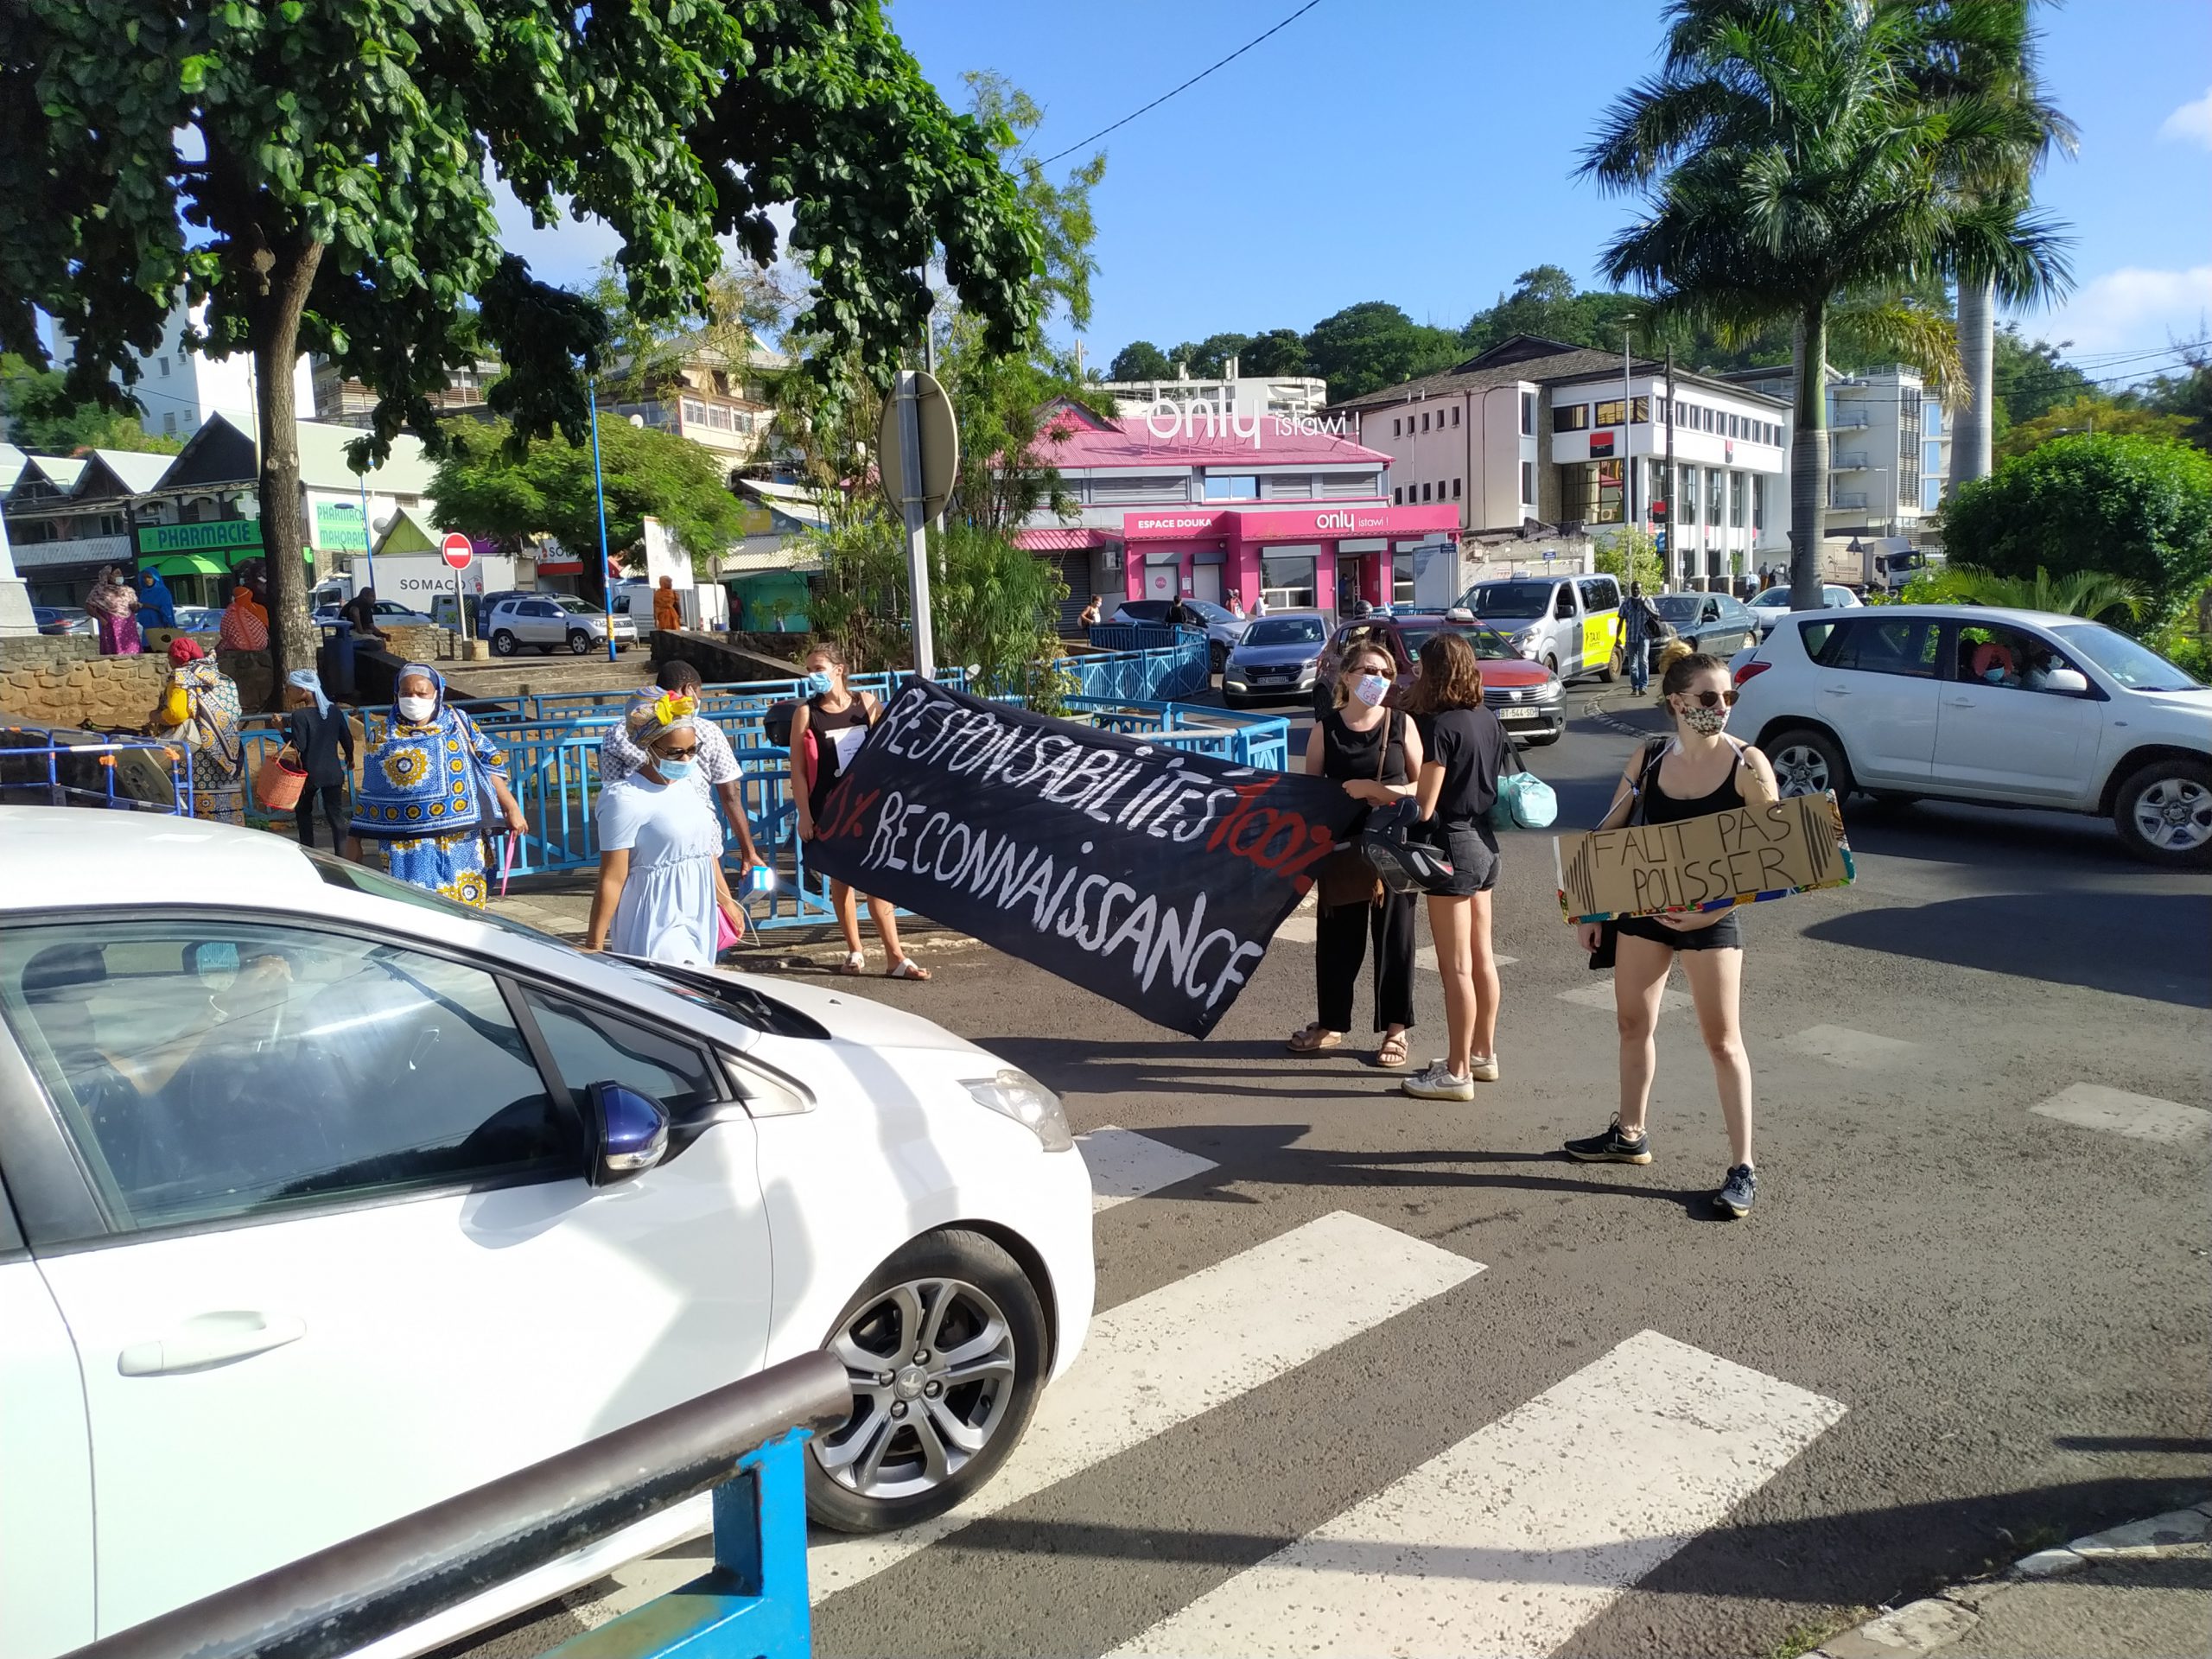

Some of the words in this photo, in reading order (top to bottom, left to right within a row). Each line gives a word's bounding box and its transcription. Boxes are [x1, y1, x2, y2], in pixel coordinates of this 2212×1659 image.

[1146, 386, 1262, 450] only
[1274, 410, 1347, 436] istawi
[157, 522, 251, 549] PHARMACIE
[1137, 519, 1175, 530] ESPACE
[1176, 518, 1213, 528] DOUKA
[1315, 510, 1354, 531] only
[1357, 517, 1384, 527] istawi
[1589, 632, 1601, 642] TAXI
[1206, 773, 1336, 895] 100%
[1592, 821, 1693, 869] FAUT
[1717, 803, 1792, 853] PAS
[1632, 847, 1798, 912] POUSSER
